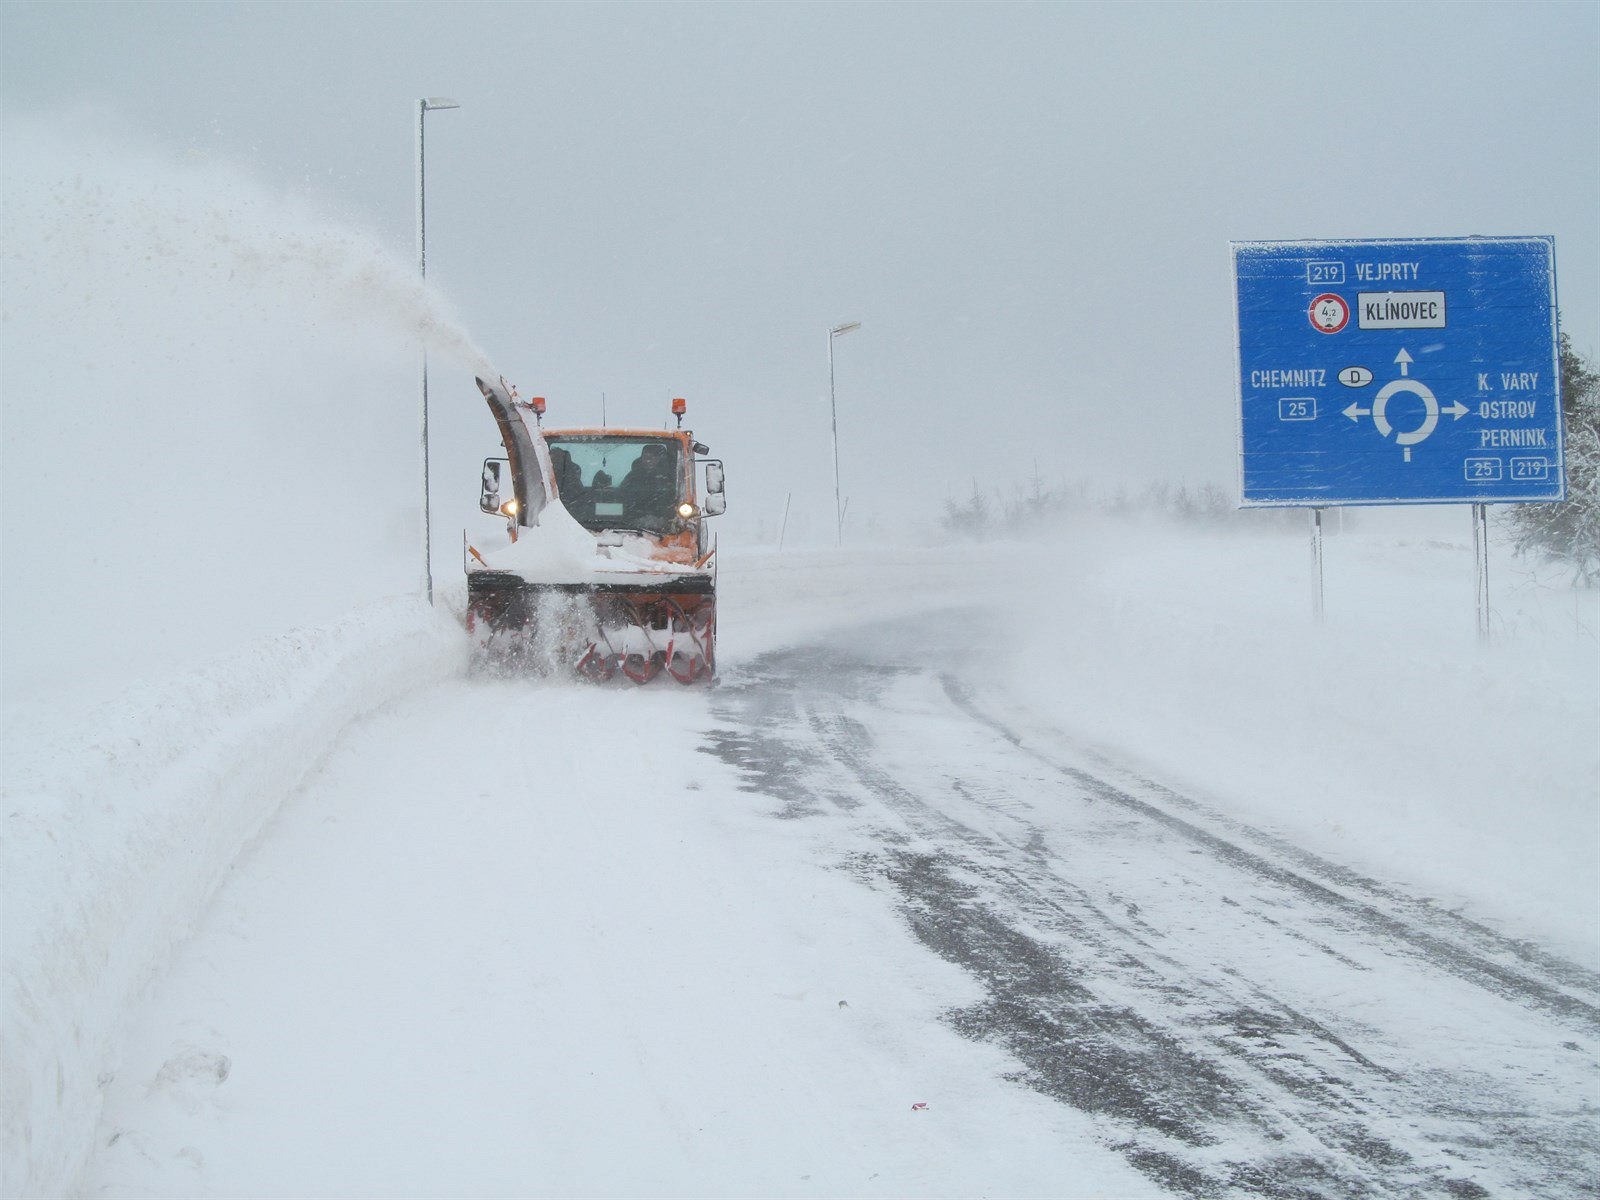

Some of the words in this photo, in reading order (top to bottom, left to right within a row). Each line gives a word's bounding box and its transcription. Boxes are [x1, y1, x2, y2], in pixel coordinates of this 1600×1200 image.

[1314, 267, 1338, 280] 219
[1356, 263, 1419, 281] VEJPRTY
[1367, 299, 1437, 320] KLÍNOVEC
[1251, 370, 1326, 387] CHEMNITZ
[1350, 371, 1360, 383] D
[1478, 373, 1493, 390] K.
[1502, 372, 1538, 390] VARY
[1289, 403, 1306, 415] 25
[1480, 401, 1536, 418] OSTROV
[1481, 430, 1546, 446] PERNINK
[1474, 463, 1492, 476] 25
[1517, 461, 1541, 476] 219
